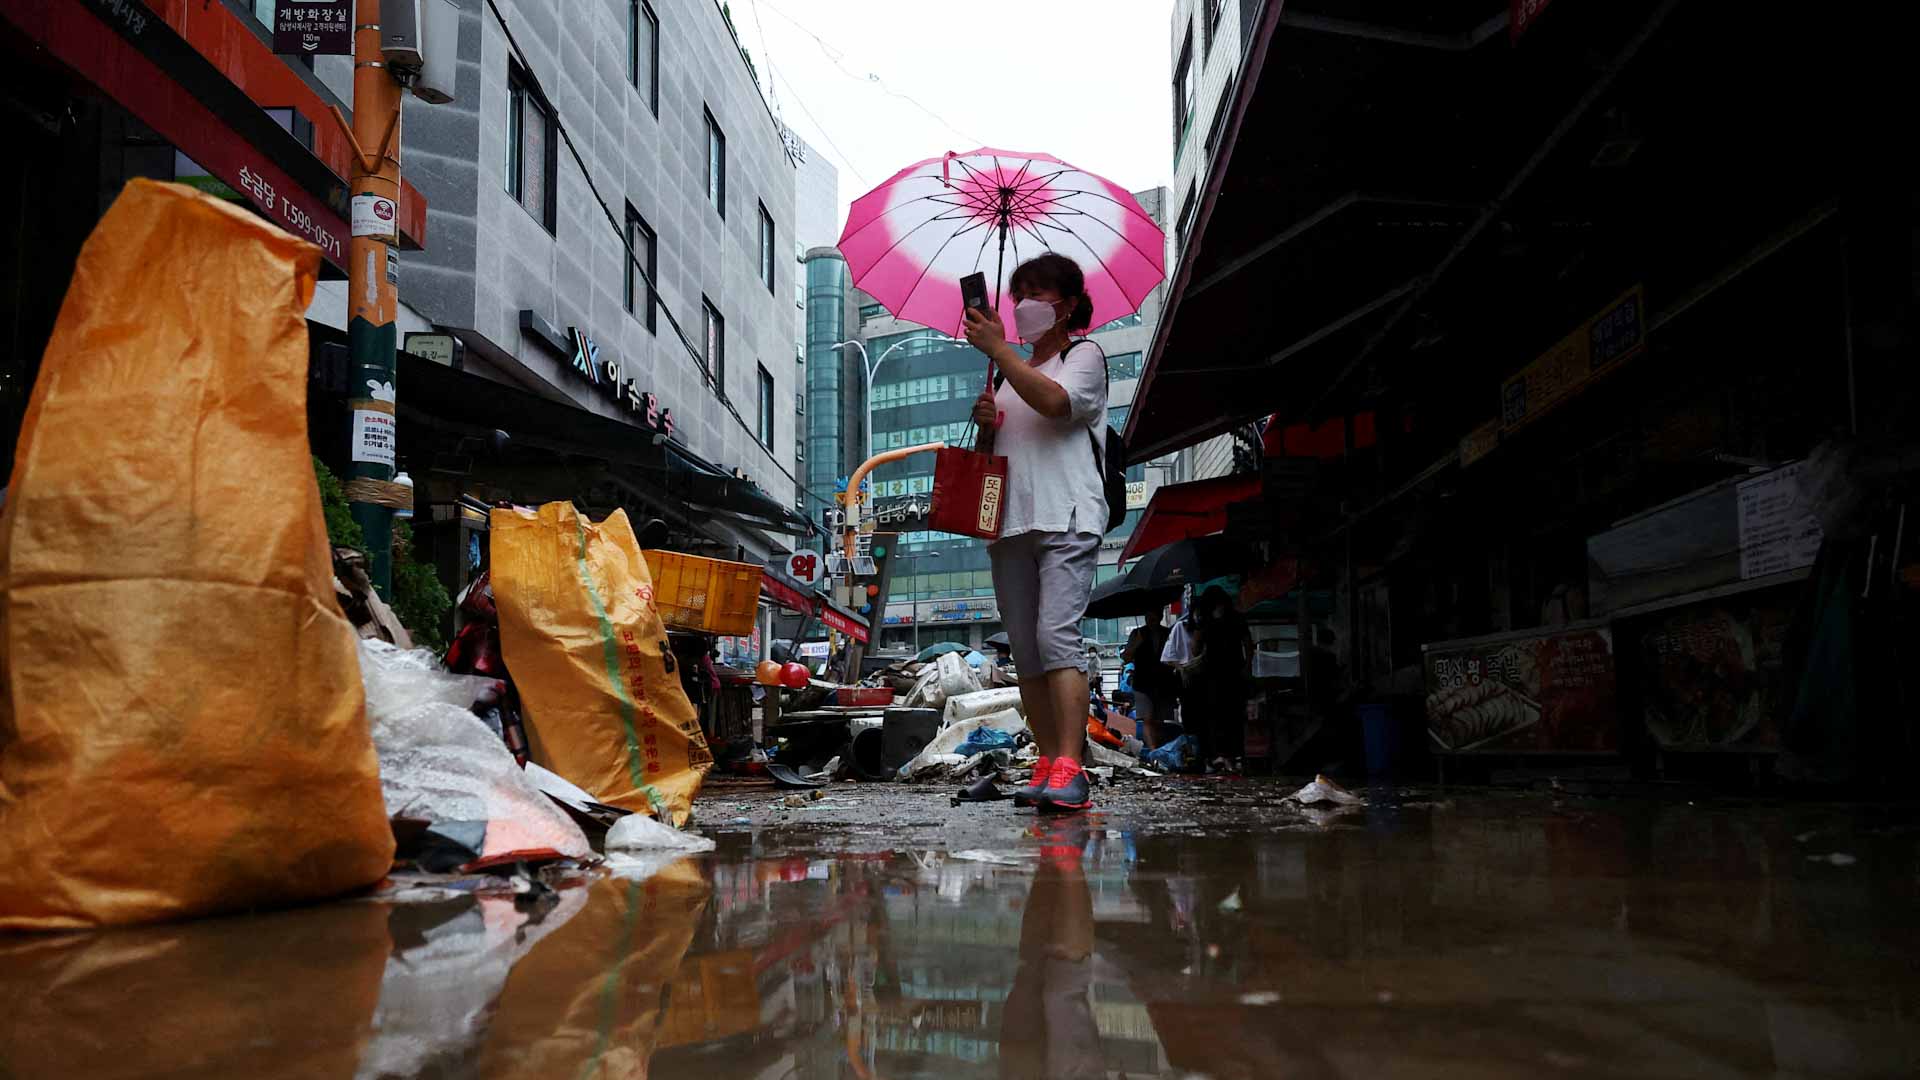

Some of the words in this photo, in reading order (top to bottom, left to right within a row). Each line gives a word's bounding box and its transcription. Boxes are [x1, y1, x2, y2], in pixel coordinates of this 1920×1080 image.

[280, 8, 347, 22] 개방화장실
[239, 165, 276, 209] 순금당
[281, 196, 341, 258] T.599-0571
[982, 478, 999, 529] 또순이네
[791, 553, 818, 583] 약
